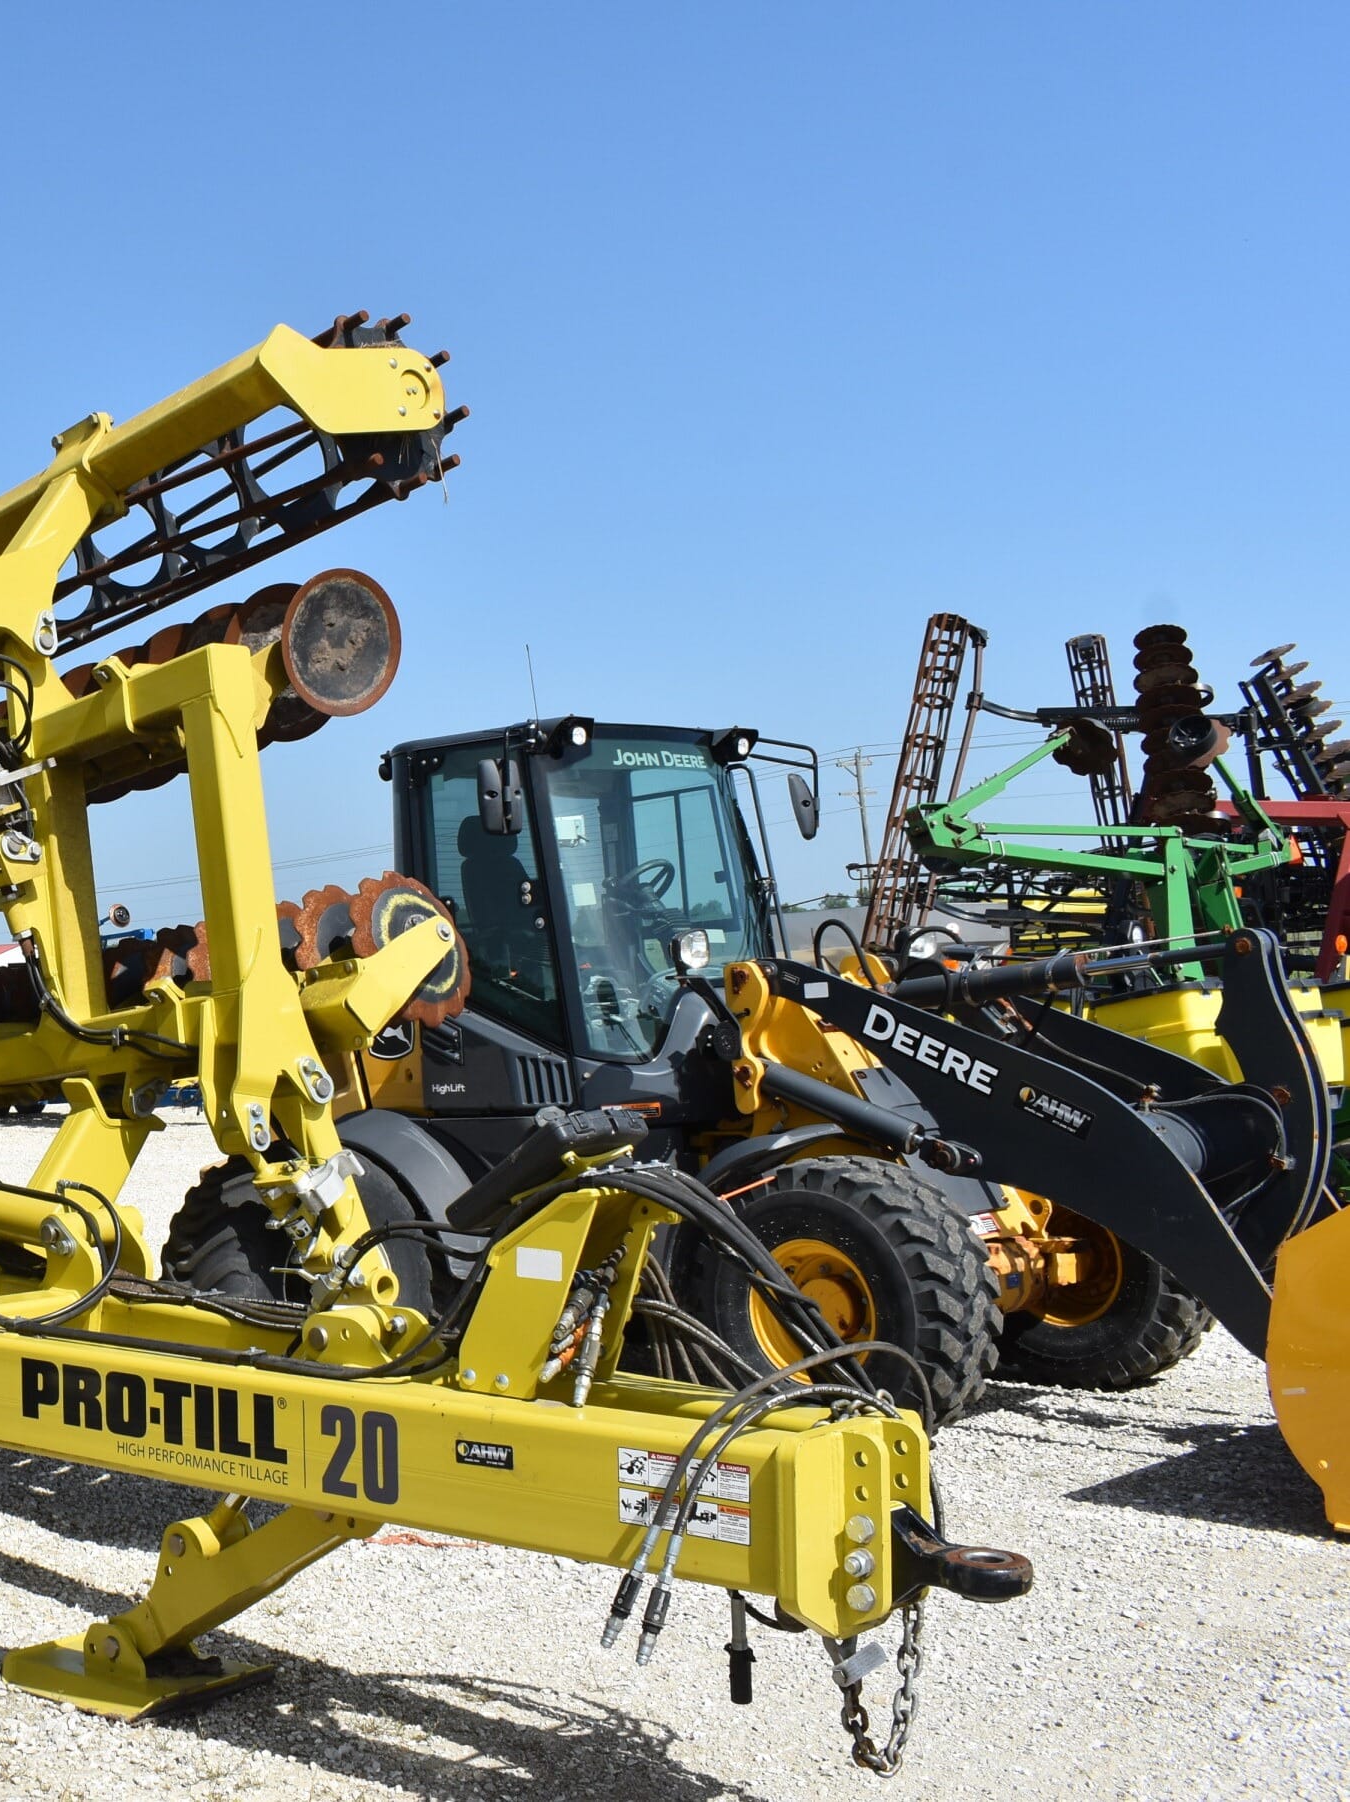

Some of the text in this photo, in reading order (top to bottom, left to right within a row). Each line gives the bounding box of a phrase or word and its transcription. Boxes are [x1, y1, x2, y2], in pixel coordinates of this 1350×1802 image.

[612, 748, 708, 769] JOHN DEERE
[862, 1003, 999, 1096] DEERE
[1032, 1094, 1087, 1128] AHW
[116, 1440, 289, 1486] HIGH PERFORMANCE TILLAGE
[320, 1404, 400, 1505] 20
[468, 1444, 509, 1461] AHW
[725, 1464, 747, 1472] DANGER
